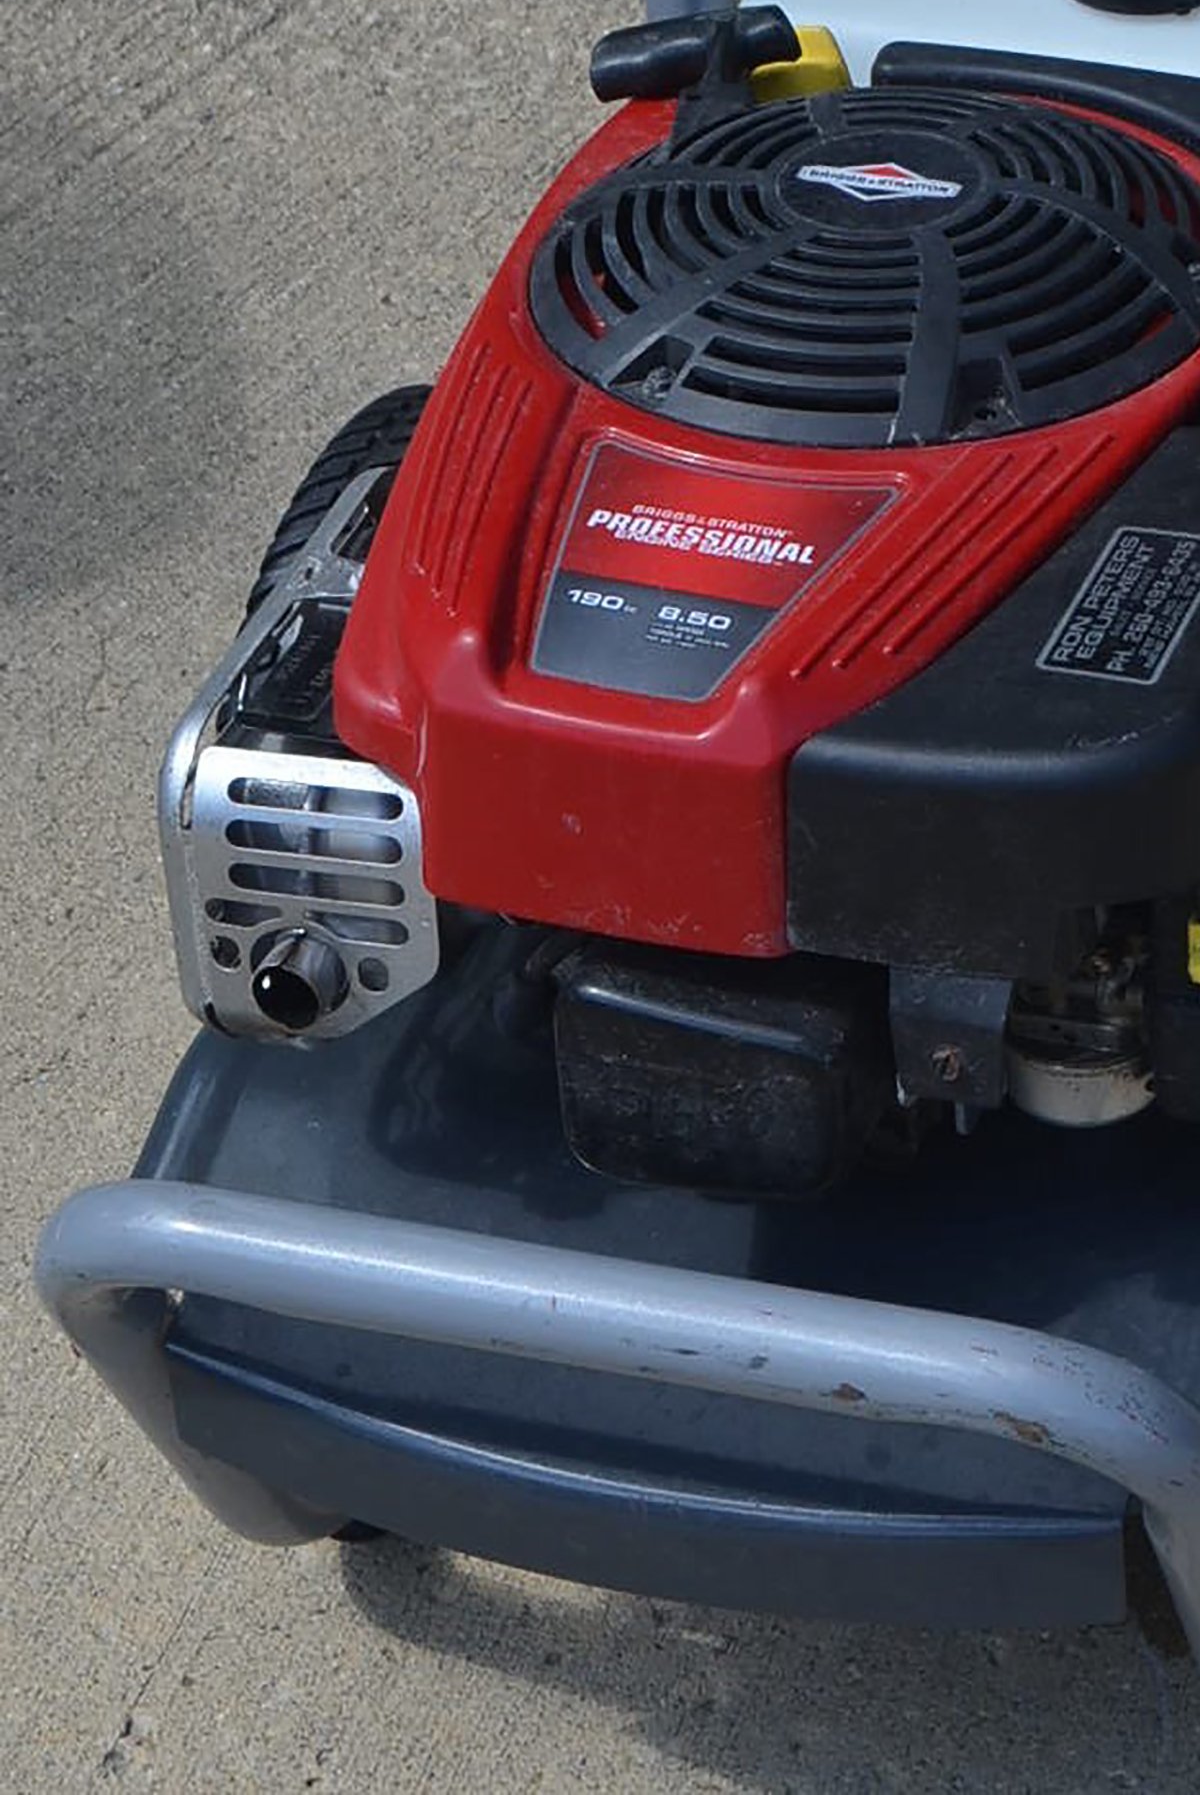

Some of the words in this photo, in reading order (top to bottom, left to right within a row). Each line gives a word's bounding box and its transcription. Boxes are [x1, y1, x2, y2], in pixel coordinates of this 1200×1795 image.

[586, 508, 815, 565] PROFESSIONAL
[567, 589, 624, 611] 190
[657, 605, 732, 631] 8.50
[1051, 615, 1092, 662] RON
[1083, 535, 1140, 610] PETERS
[1075, 544, 1155, 659] EQUIPMENT
